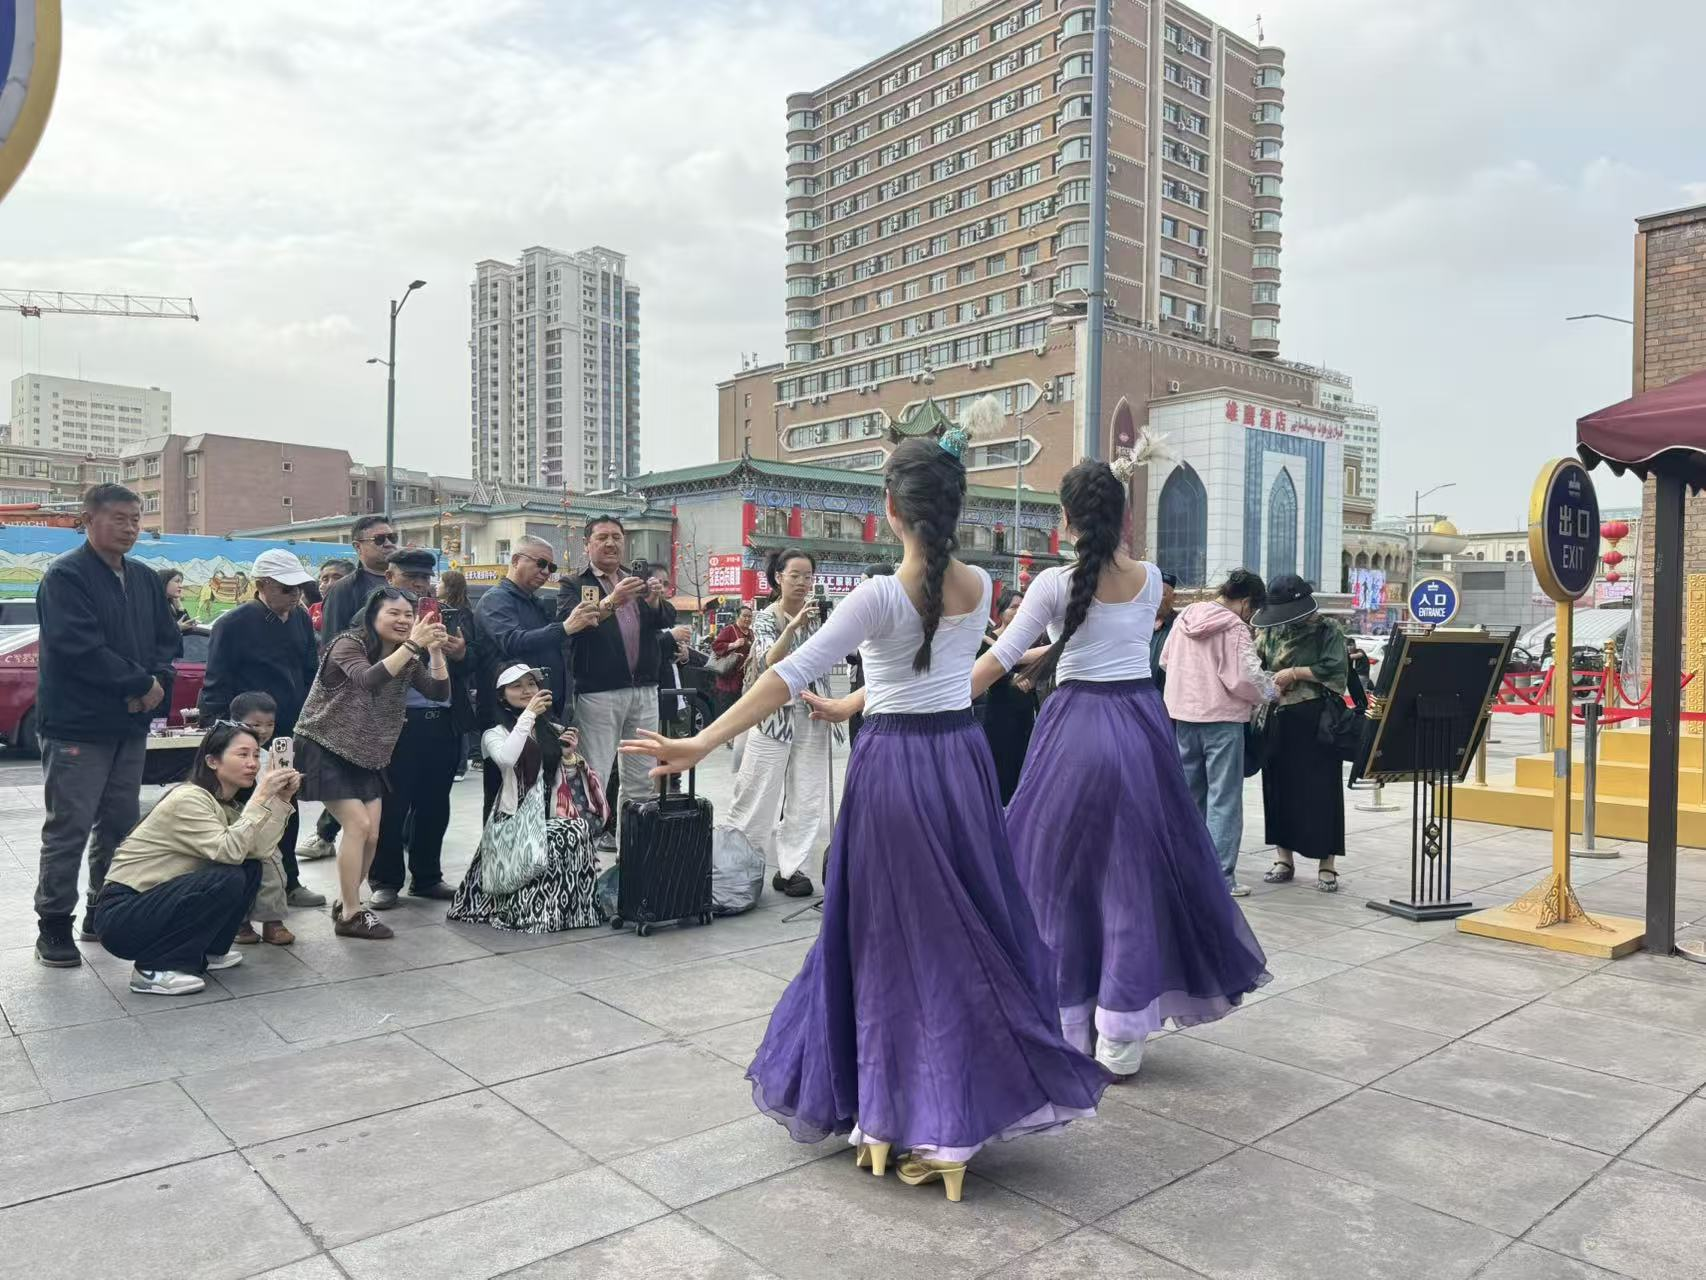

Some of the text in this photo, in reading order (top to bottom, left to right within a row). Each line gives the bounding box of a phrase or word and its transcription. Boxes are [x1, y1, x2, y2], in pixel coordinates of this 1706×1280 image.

[1559, 504, 1590, 538] 出口
[1563, 545, 1584, 569] EXIT
[1418, 607, 1447, 618] ENTRANCE
